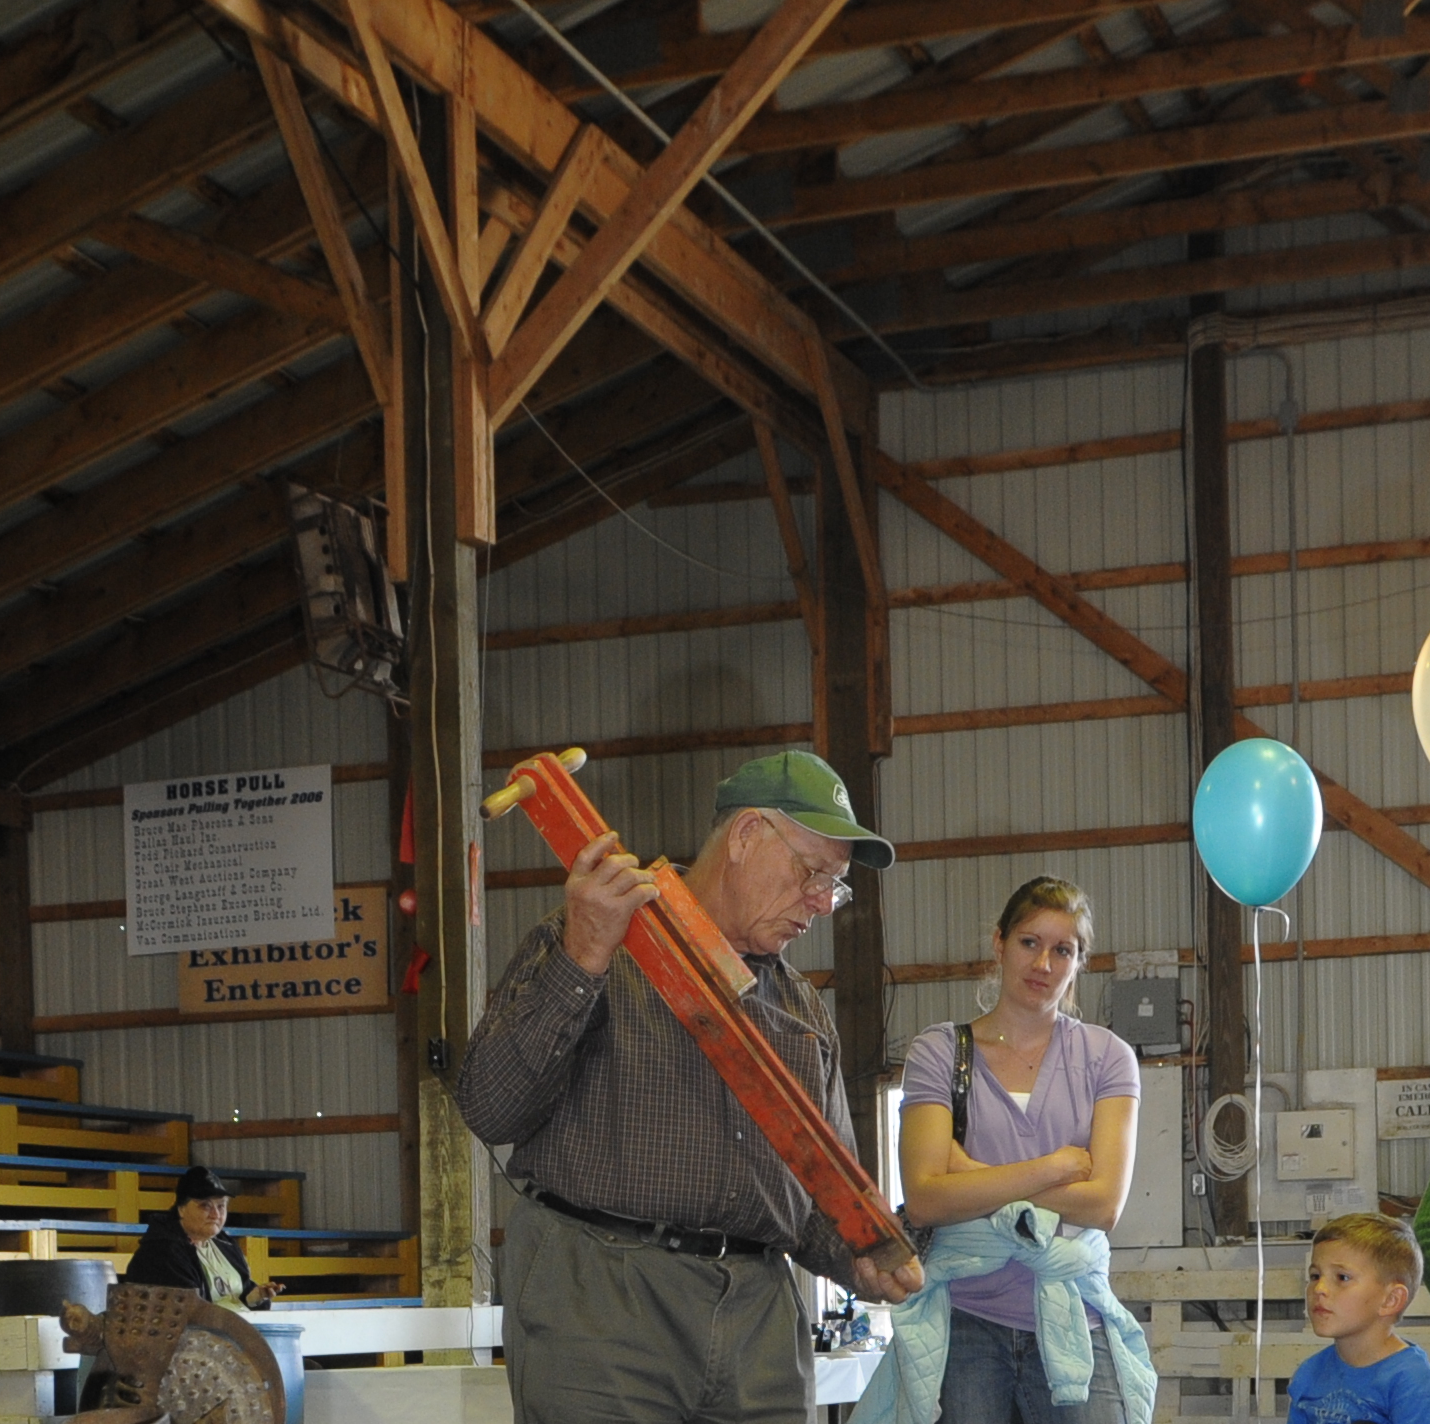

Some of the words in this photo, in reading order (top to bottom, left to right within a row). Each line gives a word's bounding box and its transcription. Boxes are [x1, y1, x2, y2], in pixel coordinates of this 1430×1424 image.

[166, 779, 229, 800] HORSE
[235, 773, 286, 793] PULL
[131, 805, 185, 823] Sponsors
[187, 801, 230, 816] Pulling
[233, 795, 288, 811] Together
[290, 790, 324, 805] 2006
[134, 825, 164, 837] Bruce
[249, 813, 274, 825] Sons
[134, 836, 167, 850] Dallas
[134, 850, 159, 863] Todd
[163, 845, 204, 860] Pickard
[208, 839, 277, 855] Construction
[135, 865, 149, 877] St.
[153, 861, 180, 875] Clair
[184, 856, 243, 872] Mechanical
[135, 877, 164, 890] Great
[168, 874, 195, 887] West
[199, 870, 245, 885] Auctions
[249, 865, 298, 881] Company
[135, 892, 171, 906] George
[174, 885, 227, 902] Langstaff
[241, 882, 267, 895] Sons
[136, 906, 166, 919] Bruce
[169, 902, 217, 918] Stephens
[221, 895, 283, 911] Excavating
[136, 916, 193, 931] McCormick
[196, 914, 249, 928] Insurance
[253, 908, 297, 922] Brokers
[301, 905, 325, 918] Ltd.
[136, 934, 157, 946] Van
[161, 928, 247, 944] Communications
[188, 934, 377, 968] Exhibitor's
[204, 977, 362, 1002] Entrance
[1401, 1085, 1413, 1093] IN
